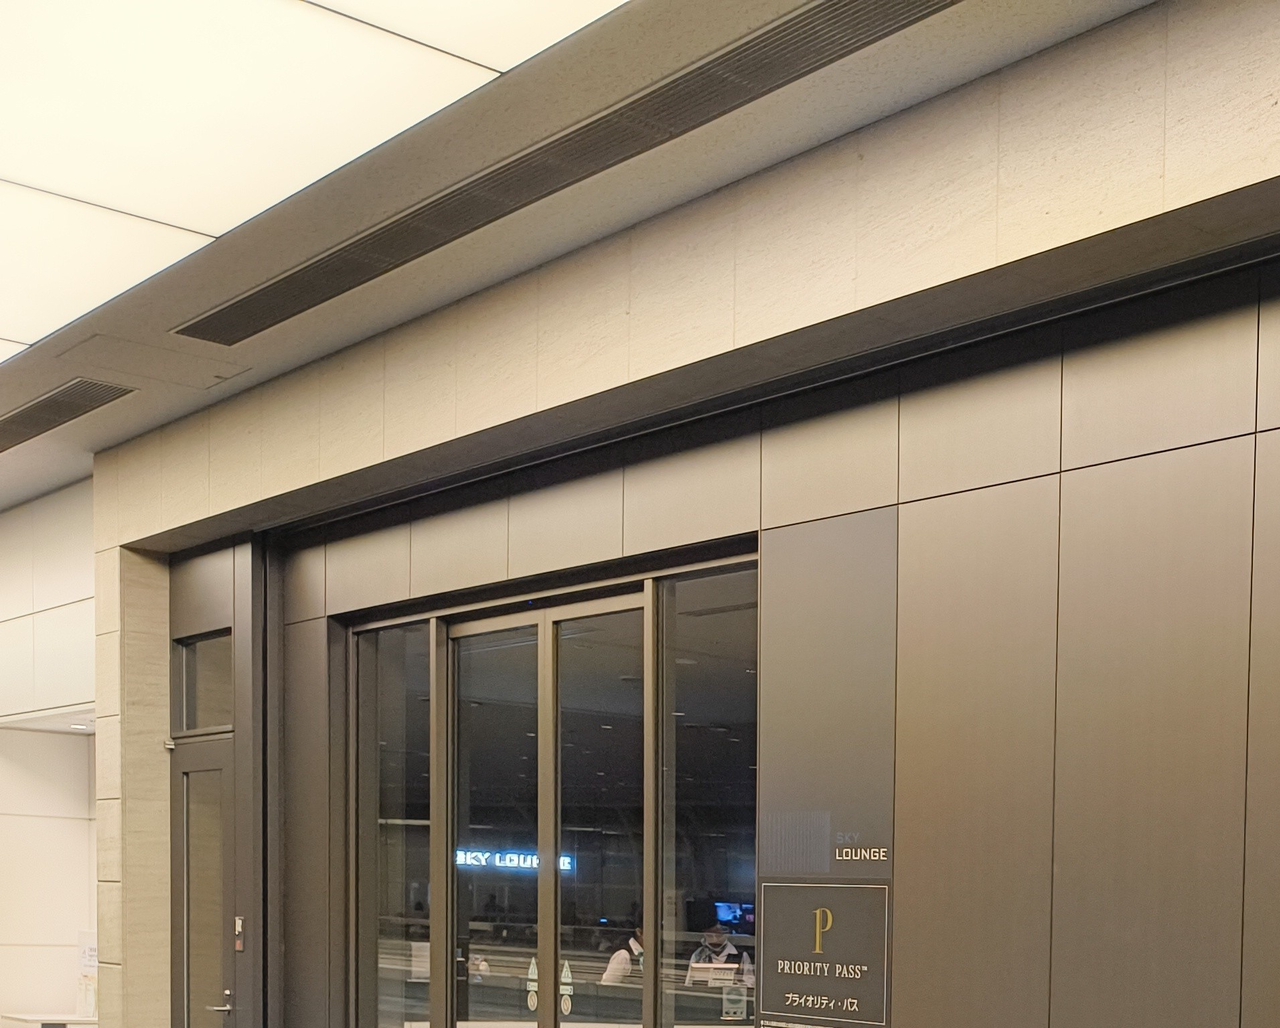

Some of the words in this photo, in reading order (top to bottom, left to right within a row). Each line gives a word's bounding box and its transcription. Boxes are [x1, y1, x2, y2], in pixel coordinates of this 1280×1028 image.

[836, 832, 859, 843] SKY
[494, 852, 572, 870] LOUE
[835, 848, 888, 861] LOUNGE
[777, 960, 830, 977] PRIORITY
